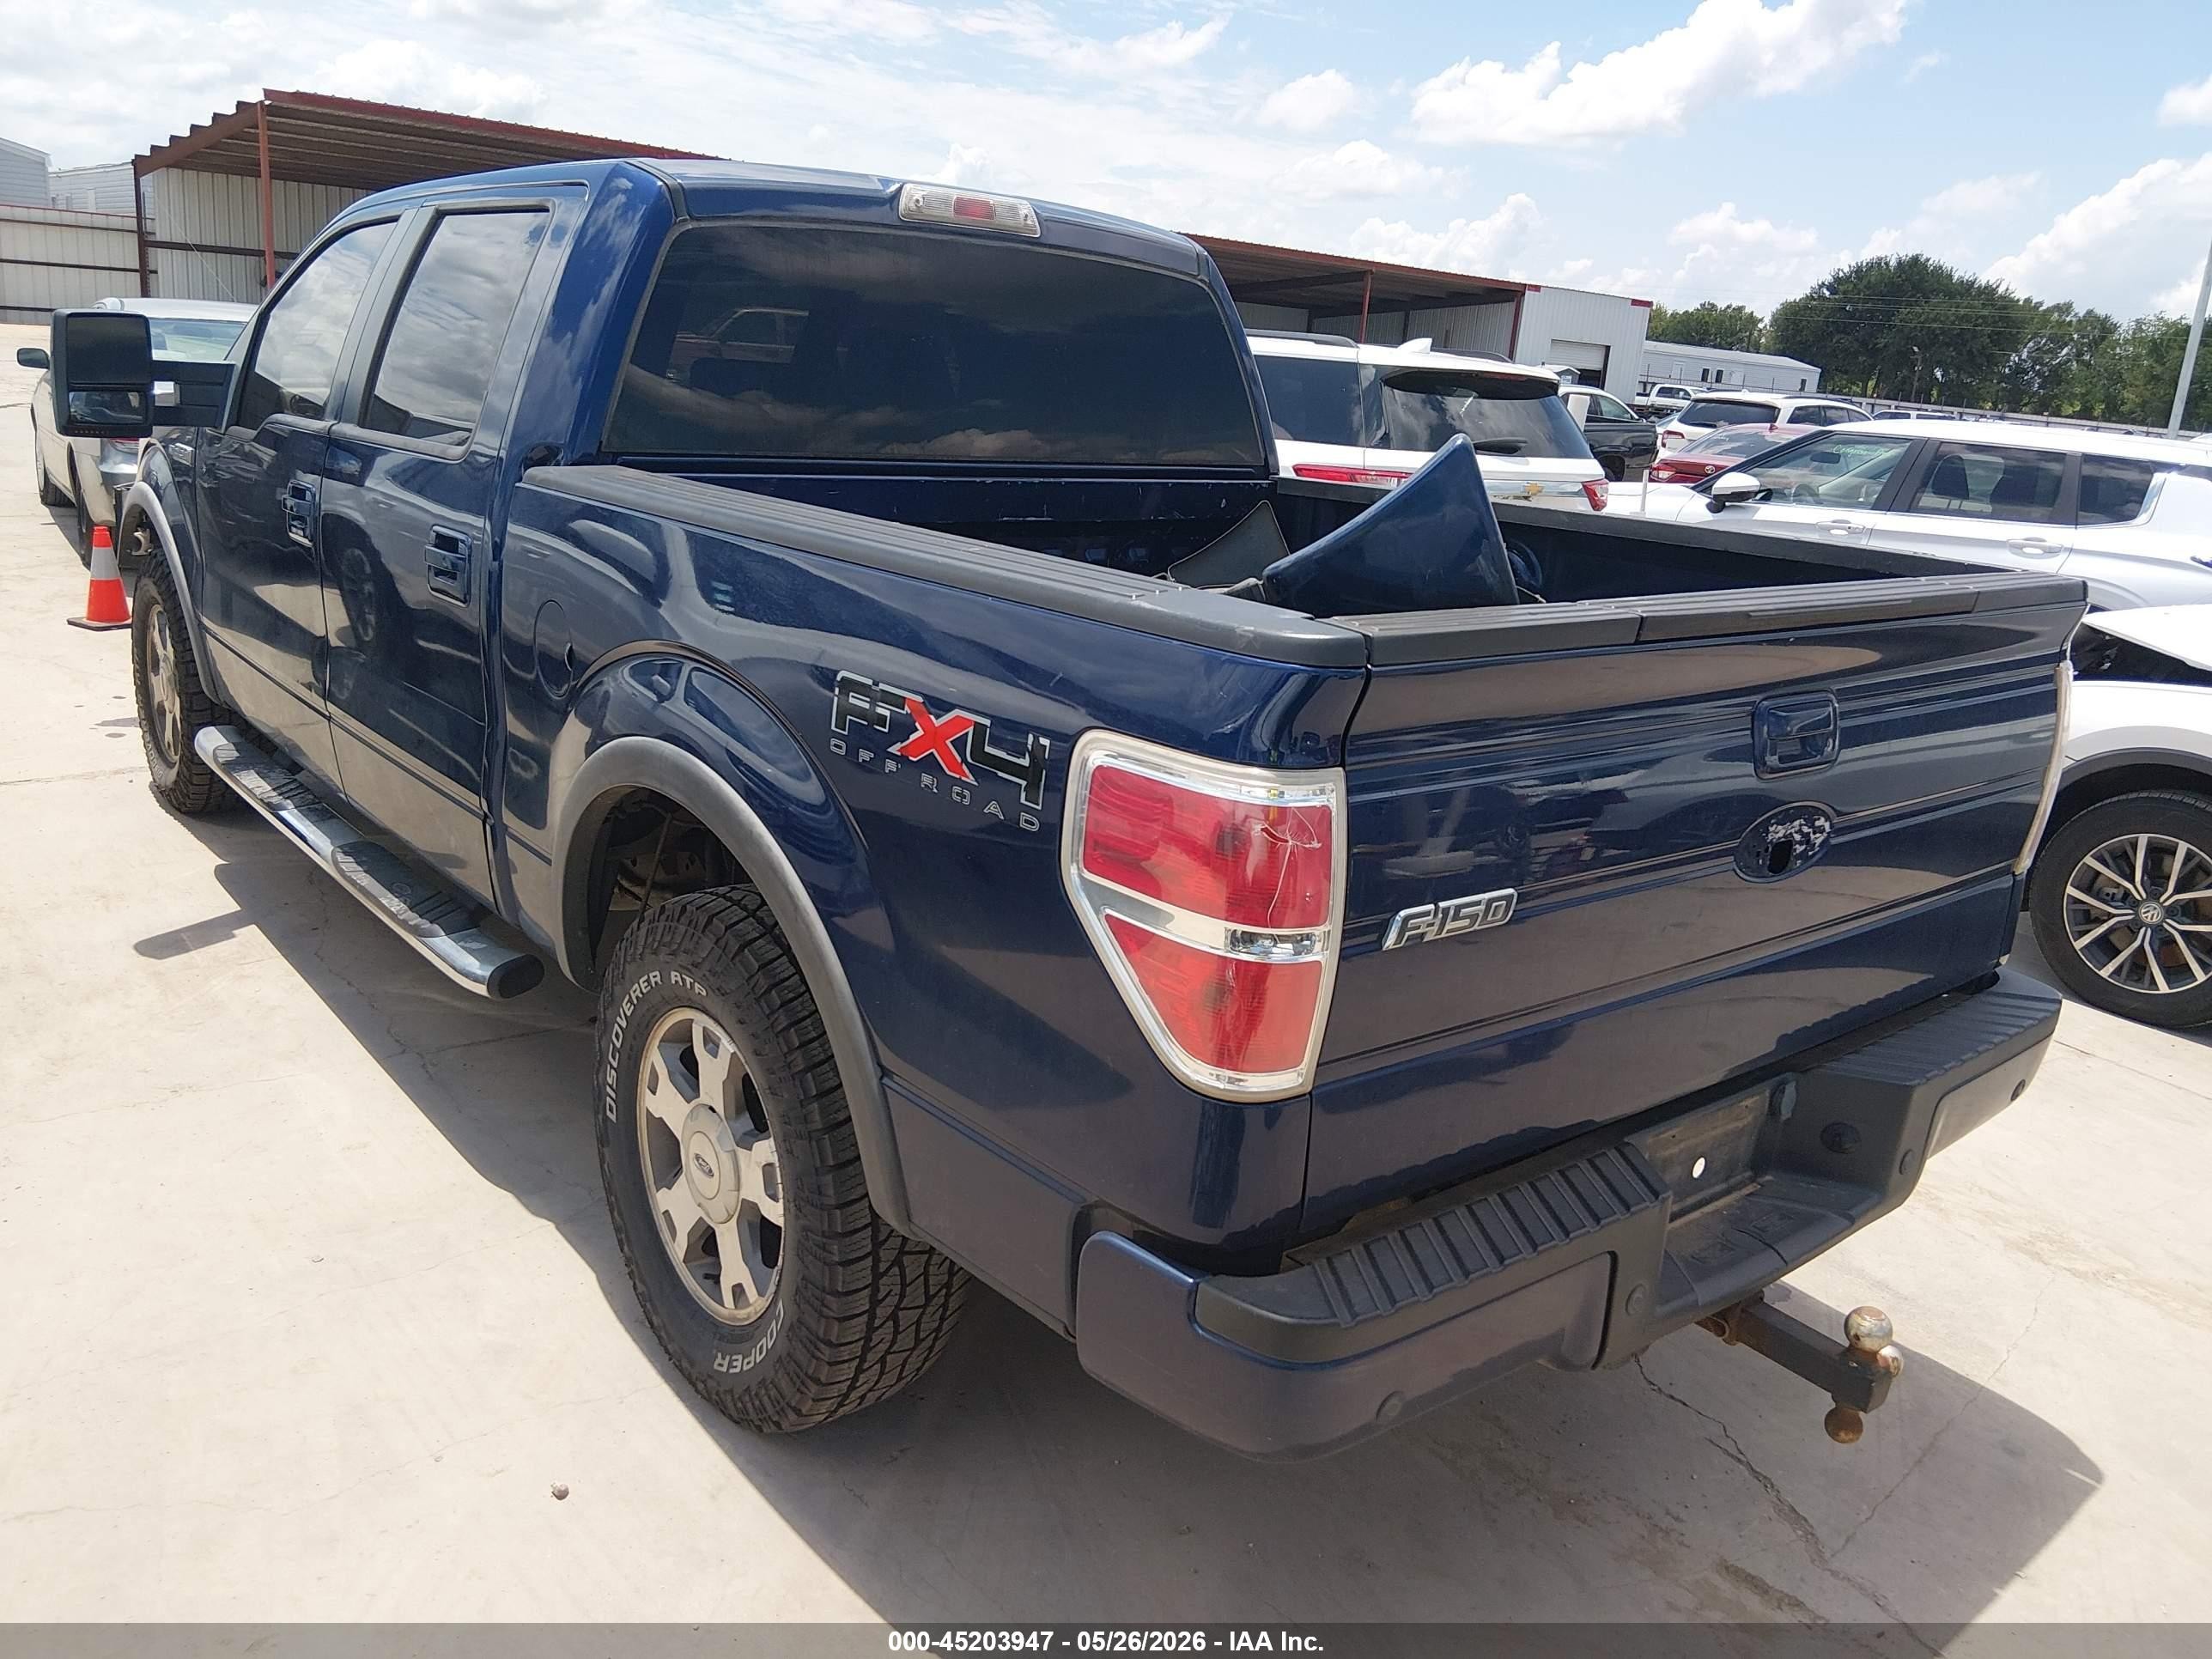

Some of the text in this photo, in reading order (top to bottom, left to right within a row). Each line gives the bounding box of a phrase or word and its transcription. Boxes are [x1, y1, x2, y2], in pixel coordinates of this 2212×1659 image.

[830, 738, 1041, 832] OFF ROAD
[831, 670, 1051, 810] FX4
[606, 970, 708, 1123] DISCOVERER ATP
[714, 1298, 784, 1373] COOPER
